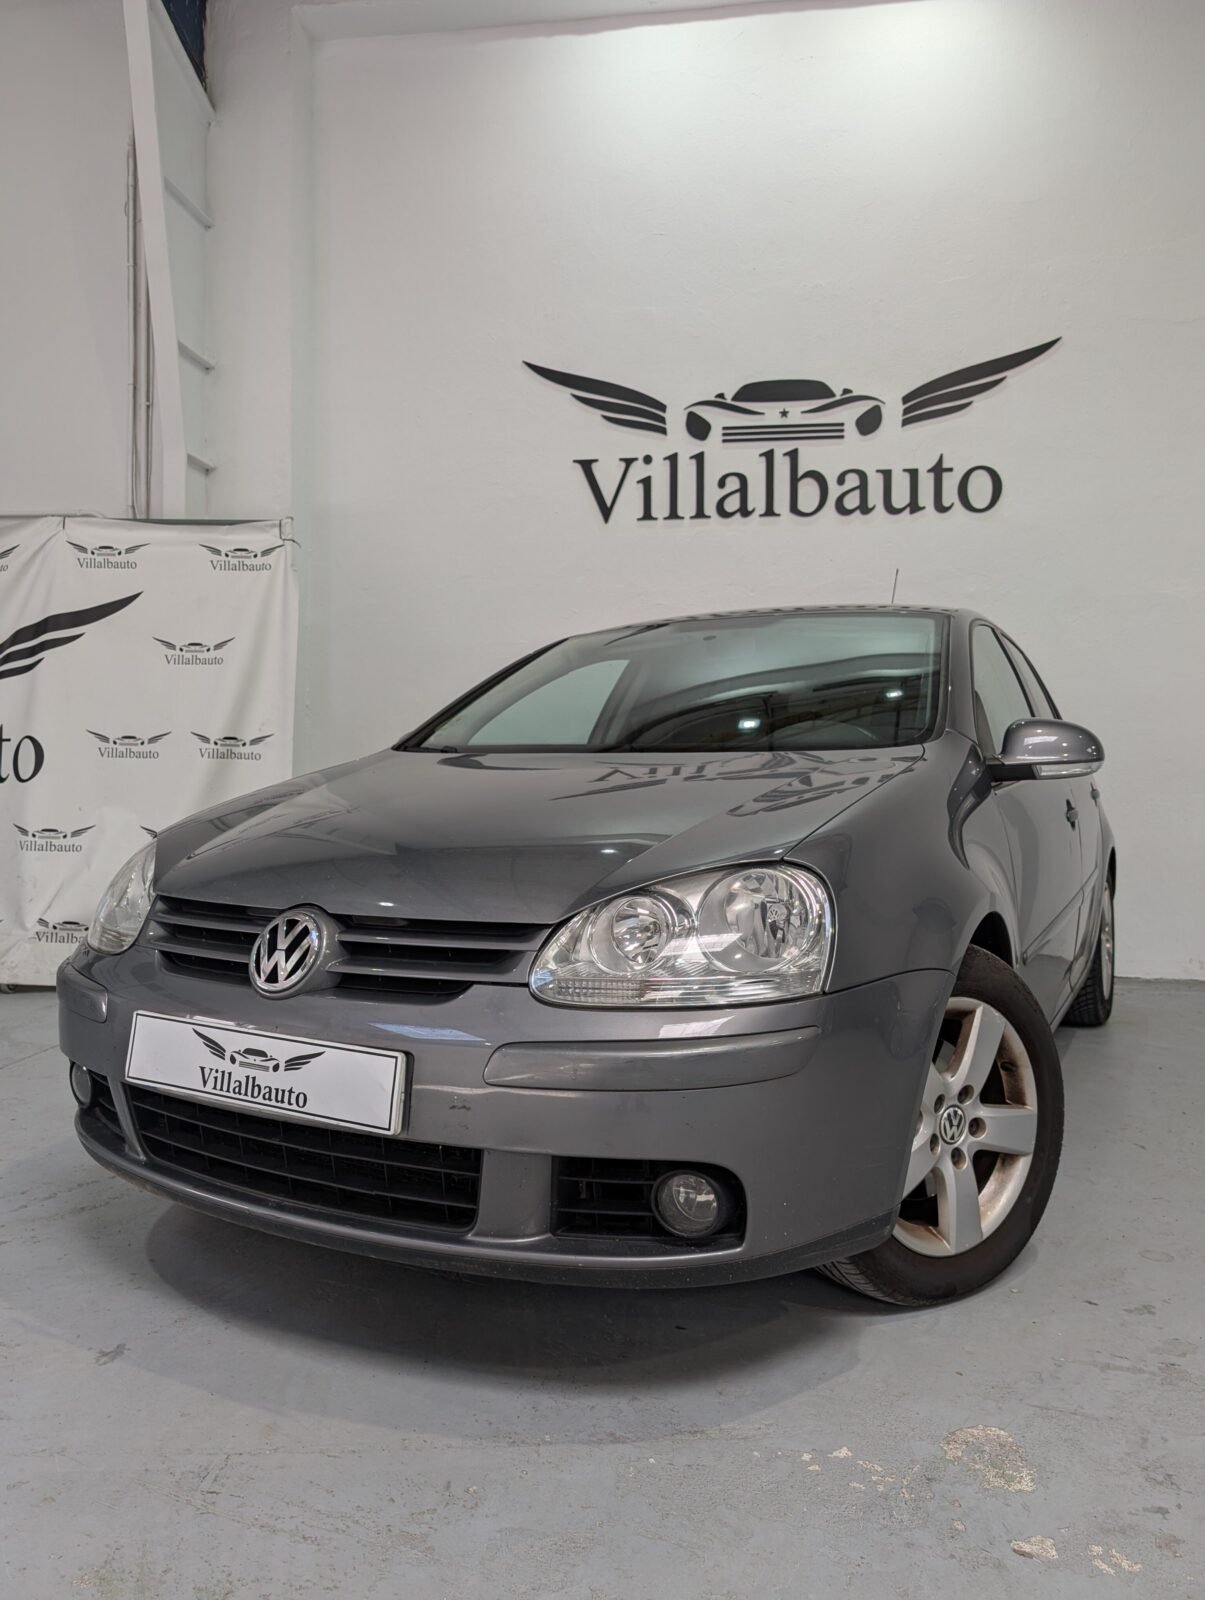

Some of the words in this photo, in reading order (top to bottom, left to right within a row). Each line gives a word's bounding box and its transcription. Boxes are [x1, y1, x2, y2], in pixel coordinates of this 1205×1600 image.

[573, 448, 1003, 524] Villalbauto
[77, 557, 138, 570] Villalbauto
[210, 559, 272, 572] Villalbauto
[165, 654, 224, 666] Villalbauto
[98, 747, 160, 760] Villalbauto
[199, 748, 262, 761] Villalbauto
[19, 840, 83, 853] Villalbauto
[35, 931, 86, 944] Villalba
[251, 912, 319, 989] VW
[198, 1066, 308, 1109] Villalbauto
[941, 1106, 966, 1144] VW
